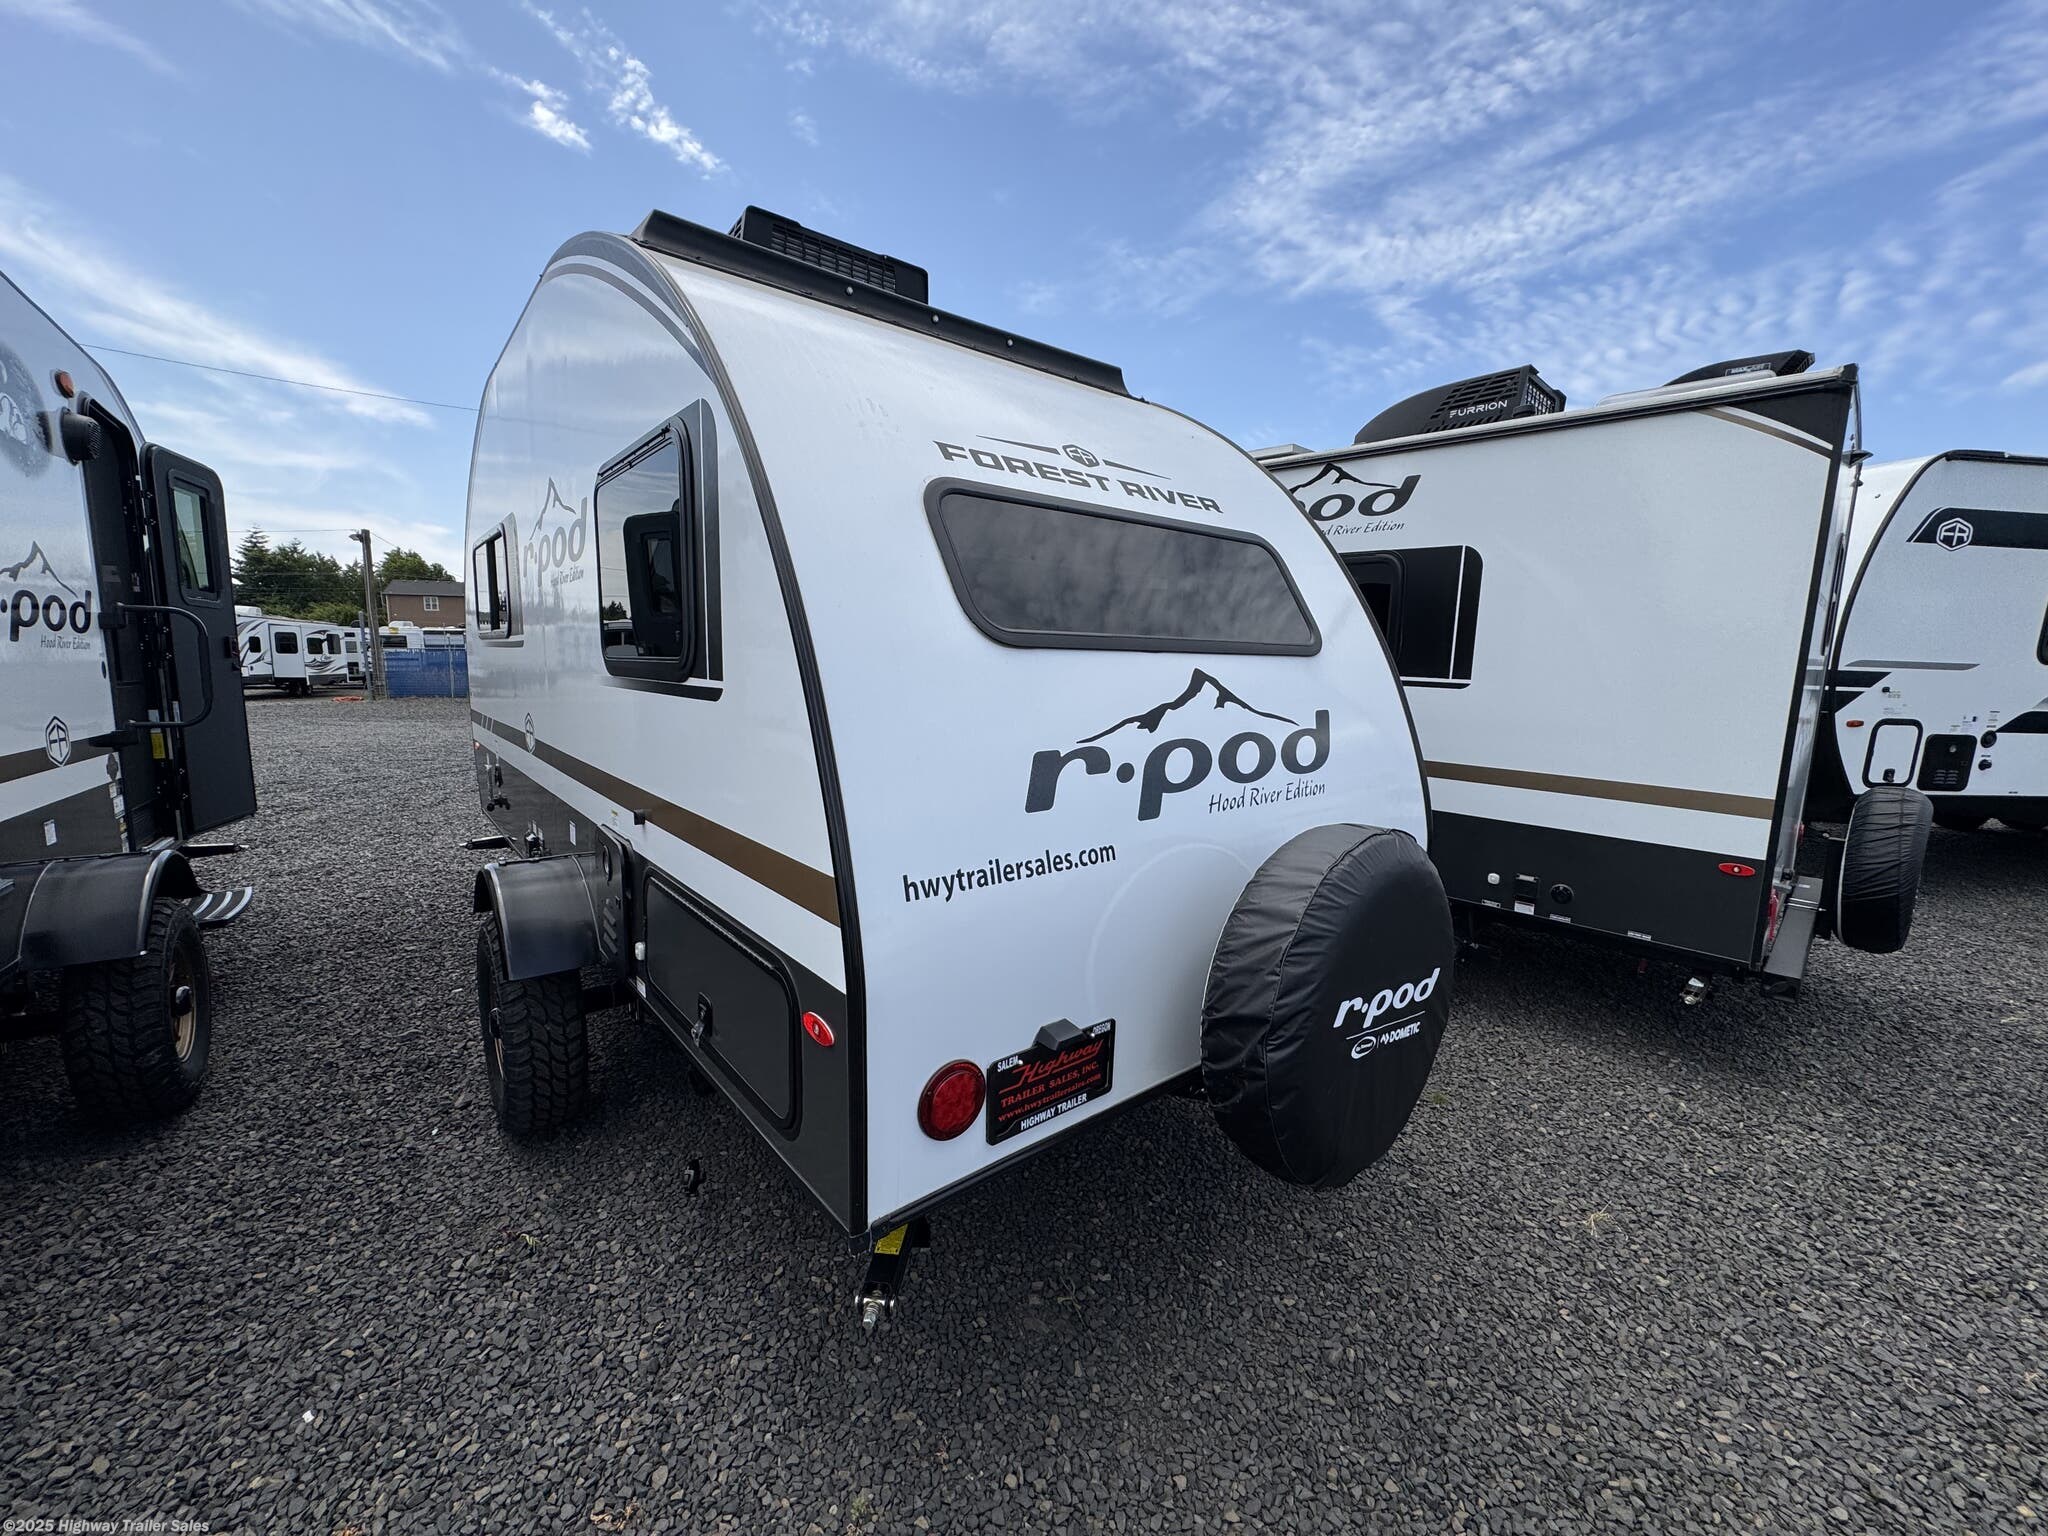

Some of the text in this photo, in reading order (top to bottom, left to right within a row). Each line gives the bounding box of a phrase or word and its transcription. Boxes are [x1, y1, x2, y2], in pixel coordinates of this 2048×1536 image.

[1449, 399, 1508, 418] FURRION
[933, 440, 1224, 514] FOREST RIVER
[1297, 474, 1422, 522] od
[1333, 524, 1363, 536] River
[1363, 519, 1406, 534] Edition
[40, 634, 91, 650] Hood River Edition
[1209, 779, 1326, 814] Hood River Edition
[902, 844, 1117, 902] hwytrailersales.com
[1389, 1021, 1421, 1043] DOMETIC
[997, 1055, 1019, 1073] SALEM
[1006, 1040, 1104, 1087] Highway
[997, 1073, 1102, 1122] www.hwytrailersales.com
[1000, 1083, 1046, 1108] TRAILER
[1082, 1061, 1100, 1075] INC.
[1020, 1093, 1088, 1131] HIGHWAY TRAILER
